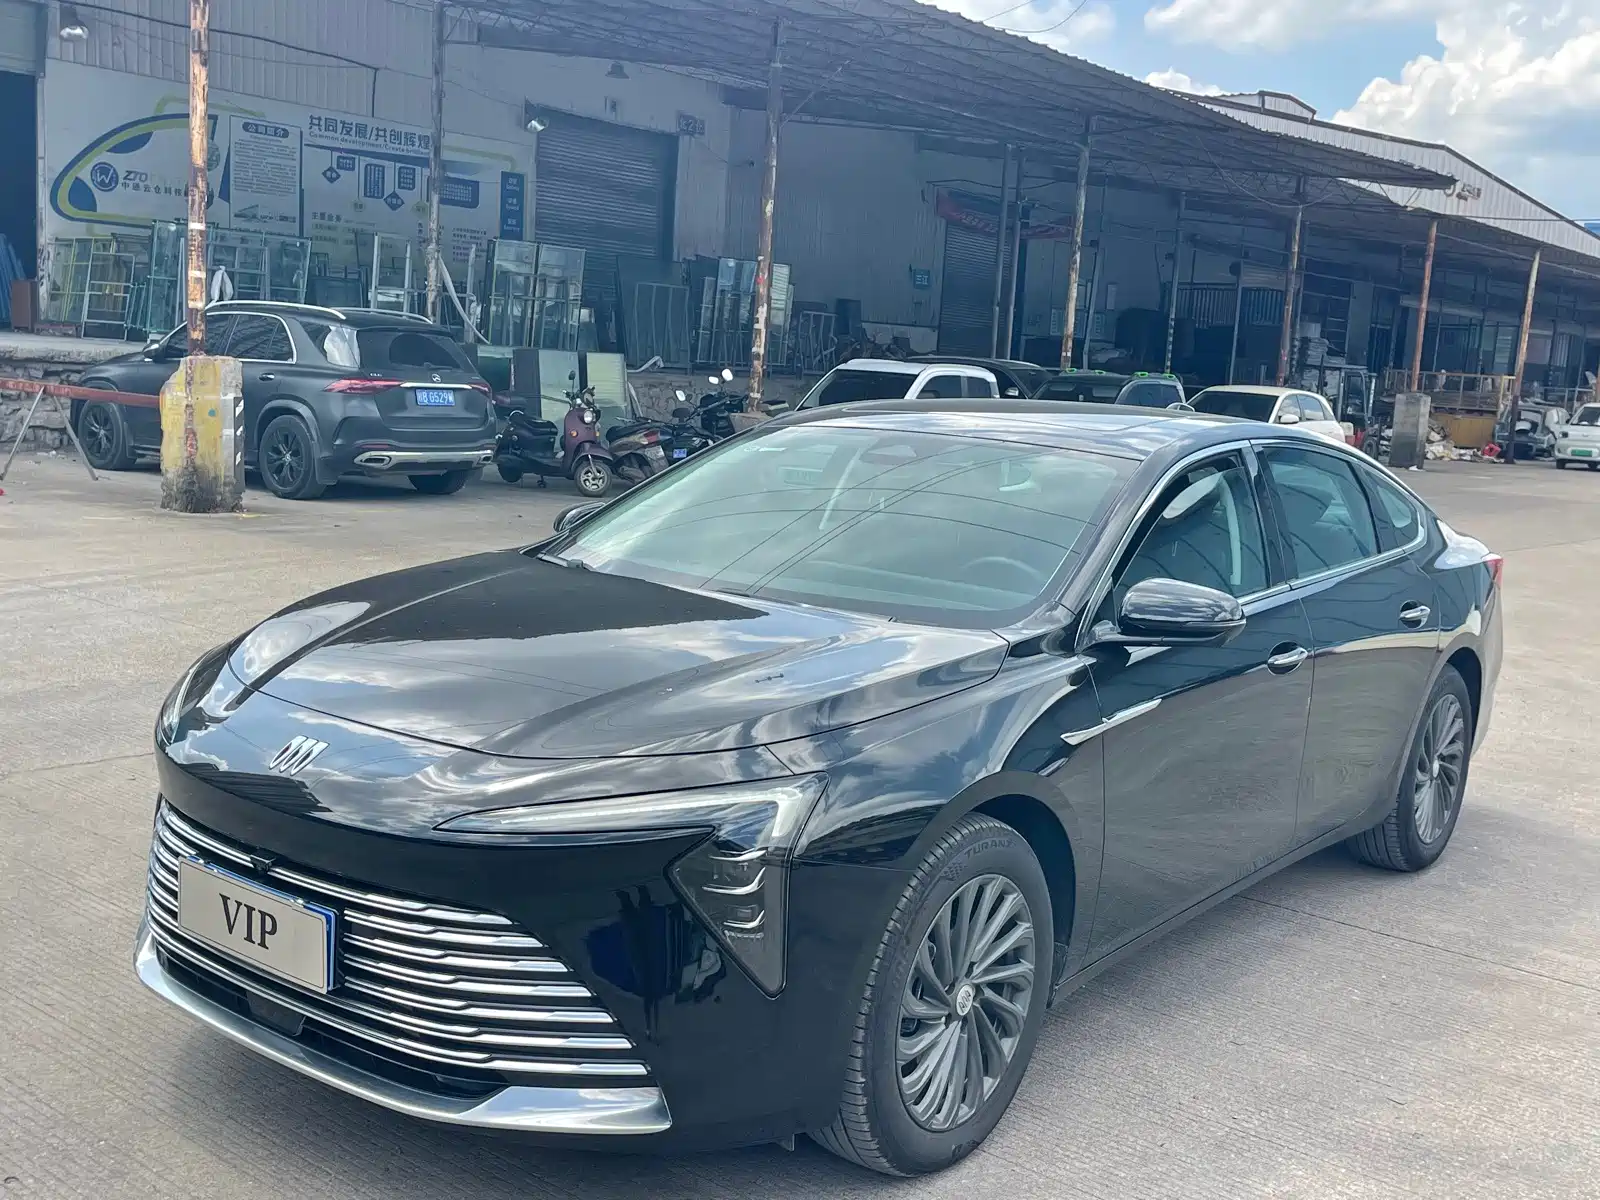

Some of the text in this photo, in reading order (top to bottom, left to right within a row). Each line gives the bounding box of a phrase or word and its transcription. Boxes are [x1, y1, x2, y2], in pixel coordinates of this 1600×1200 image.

[309, 114, 430, 150] 共同发展/共创辉煌
[123, 170, 148, 182] ZTO
[219, 893, 278, 950] VIP
